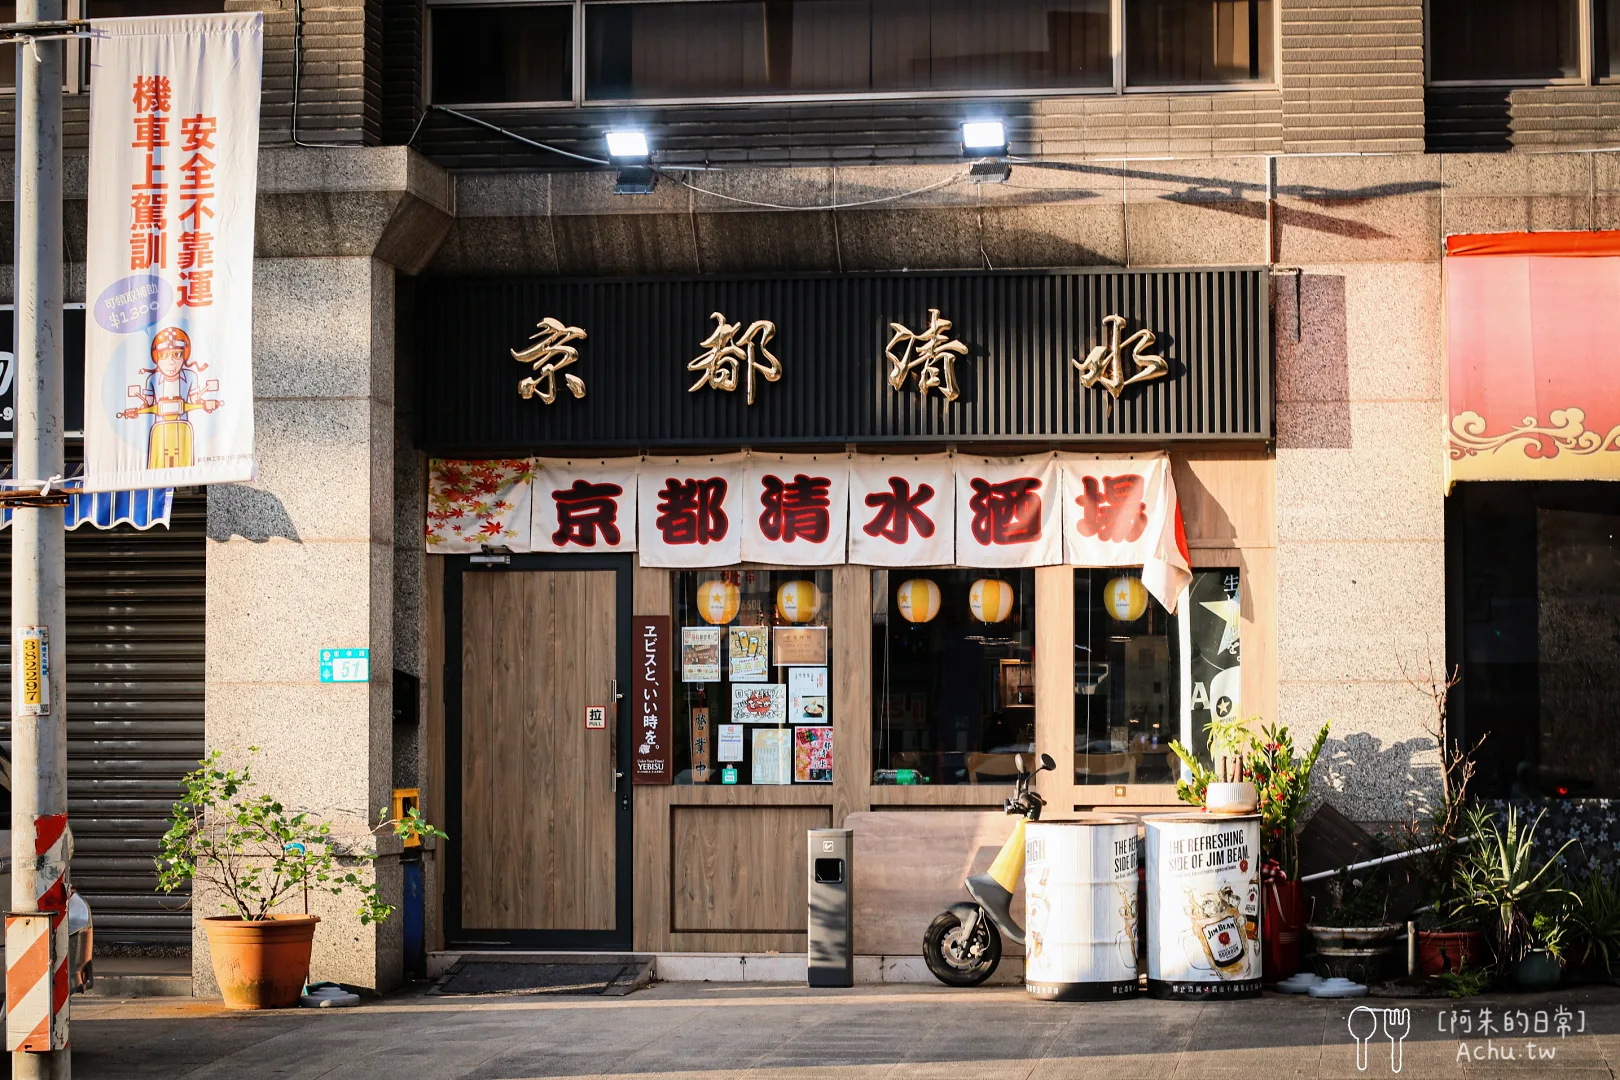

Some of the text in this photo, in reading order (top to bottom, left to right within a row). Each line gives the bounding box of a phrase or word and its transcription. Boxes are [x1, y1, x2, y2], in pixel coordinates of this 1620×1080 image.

[130, 75, 172, 271] 機車上駕訓
[176, 113, 218, 308] 安全不靠運
[104, 283, 159, 309] 可領取補助
[109, 301, 160, 329] $1300
[510, 308, 1169, 406] 京都清水
[551, 474, 1148, 548] 京都清水酒場
[25, 640, 38, 701] 382297
[589, 709, 602, 721] 拉
[637, 763, 664, 771] YEBISU
[1114, 838, 1127, 856] THE
[1168, 829, 1244, 855] THE REFRESHING
[1114, 856, 1130, 873] SIDE
[1168, 855, 1189, 872] SIDE
[1191, 853, 1204, 869] OF
[1206, 850, 1225, 867] JIM
[1207, 921, 1236, 940] JIM BEAM
